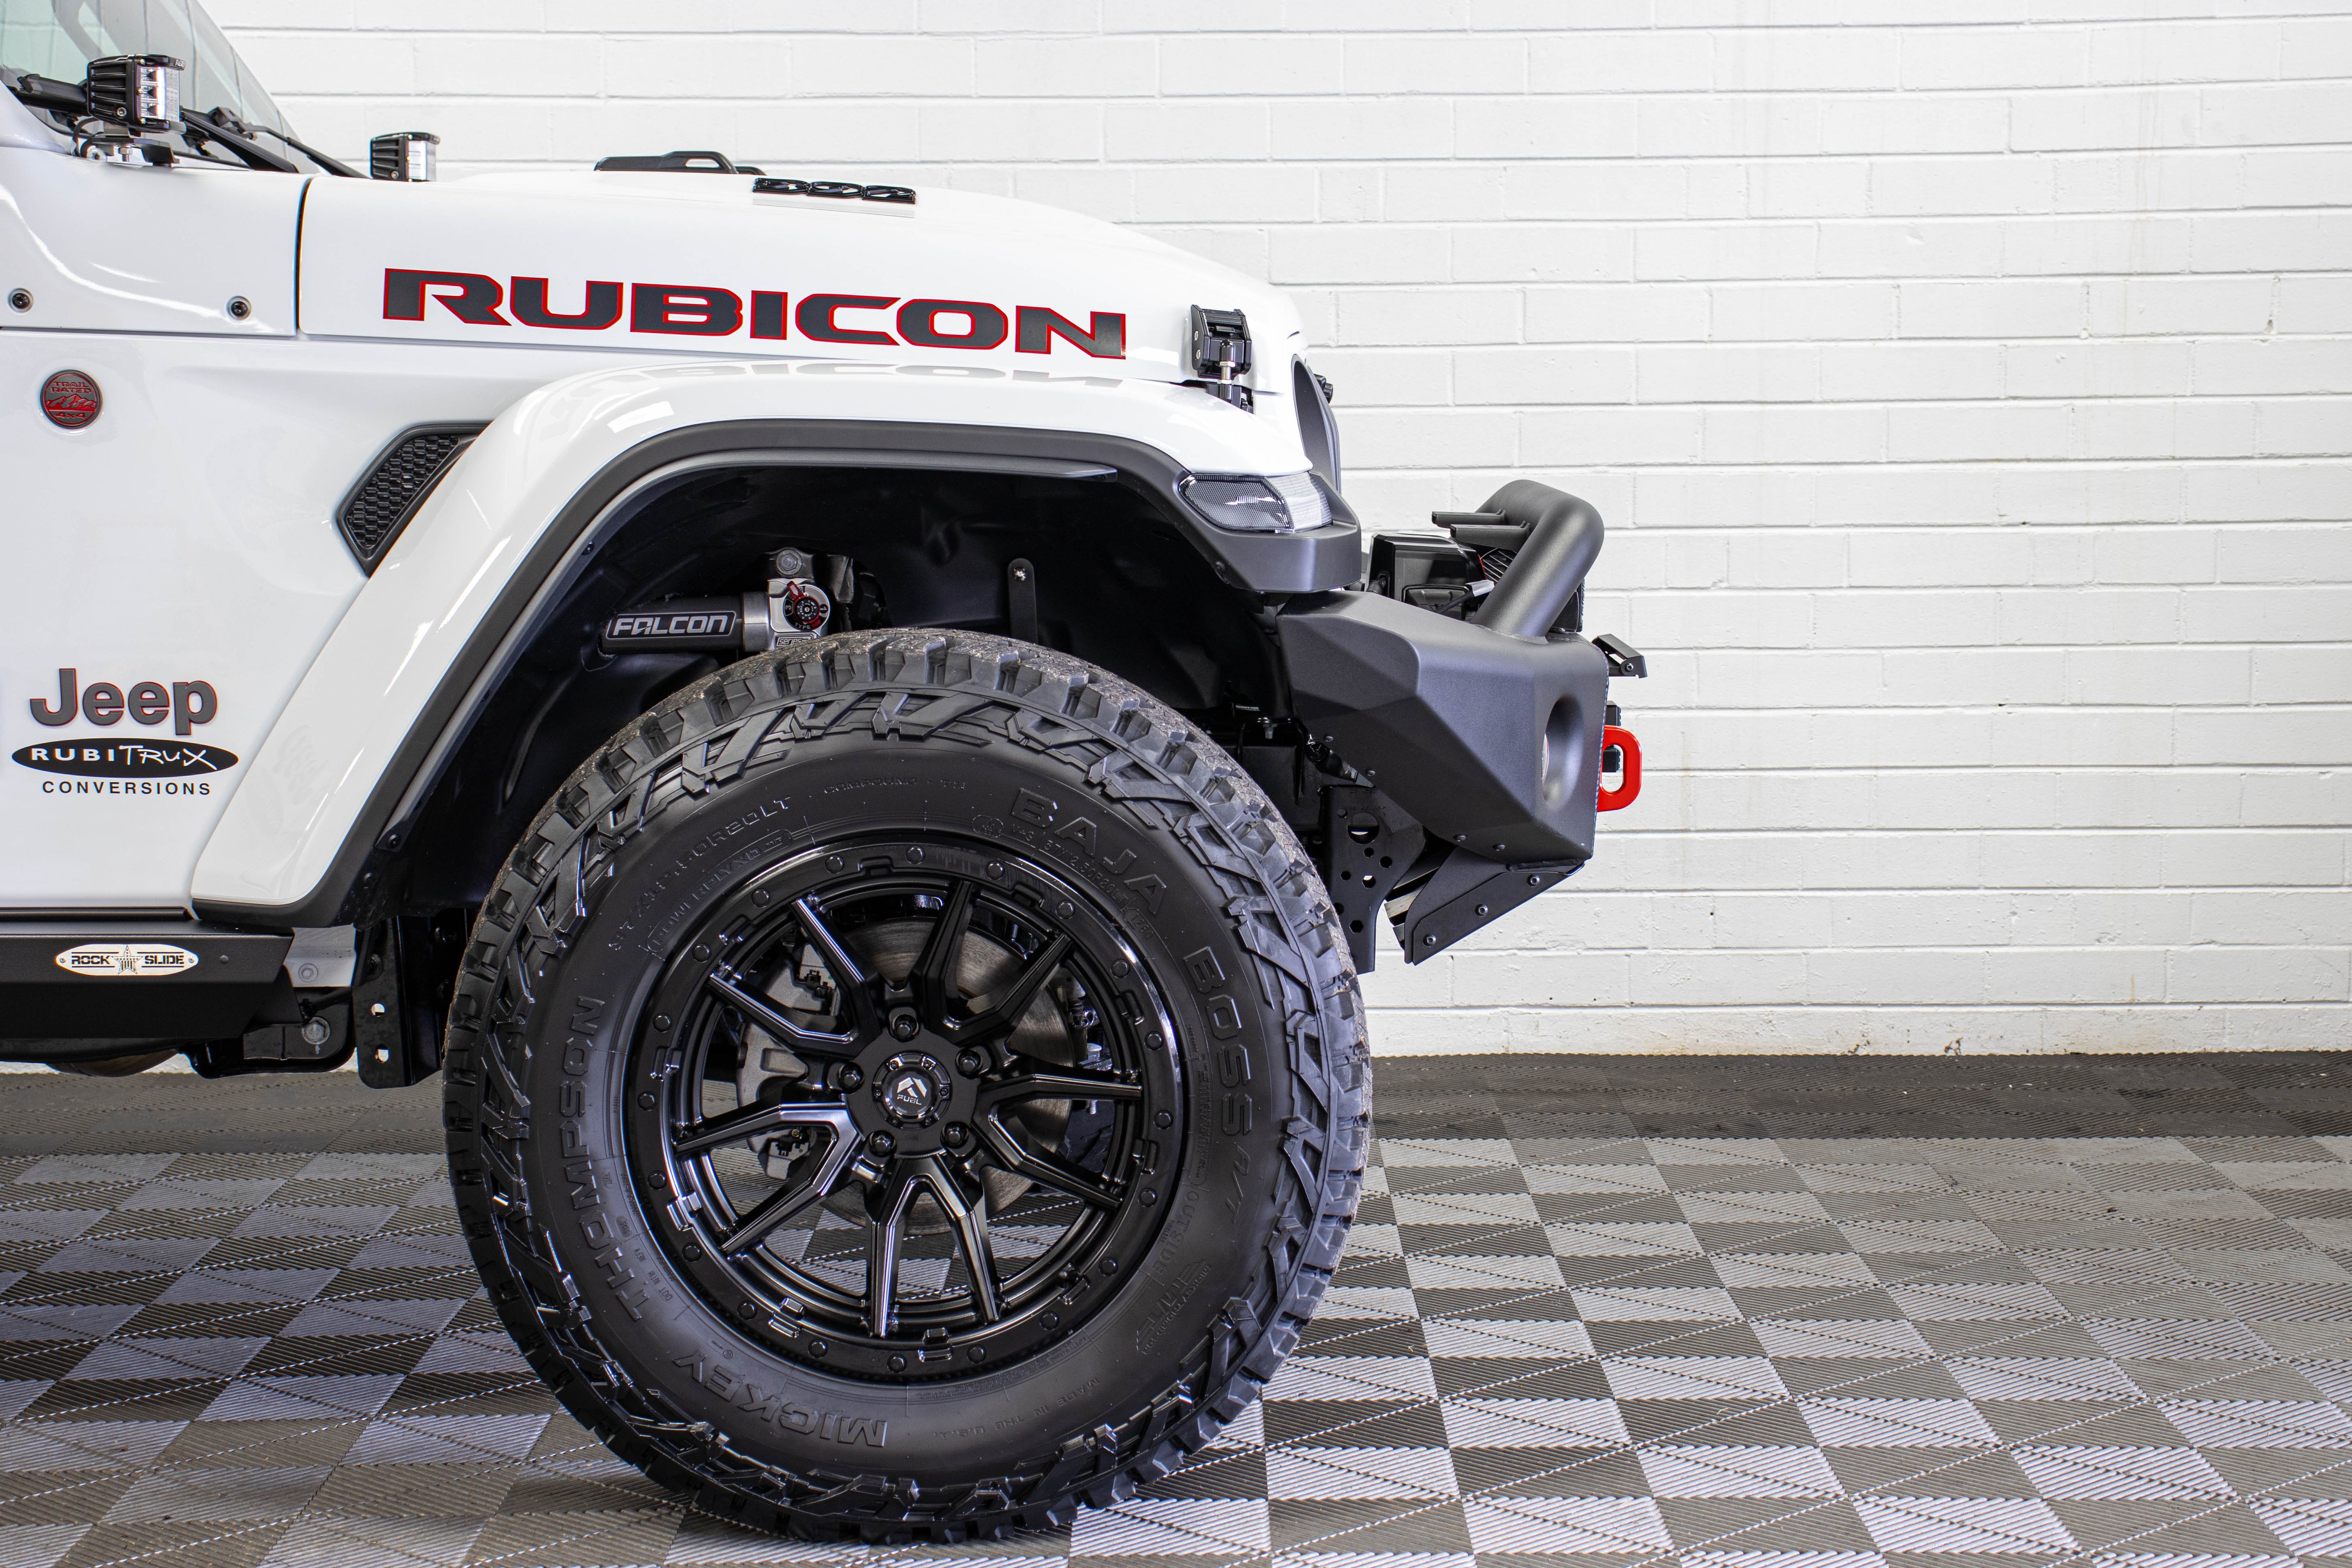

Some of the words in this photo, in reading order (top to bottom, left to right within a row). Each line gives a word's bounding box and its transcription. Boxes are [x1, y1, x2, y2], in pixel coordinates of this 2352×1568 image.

[382, 267, 1126, 360] RUBICON
[612, 615, 728, 635] FALCON
[30, 668, 217, 735] Jeep
[42, 781, 212, 795] CONVERSIONS
[71, 955, 110, 966] ROCK
[144, 955, 185, 966] SLIDE
[1011, 788, 1168, 917] BAJA
[1183, 946, 1251, 1136] BOSS
[897, 1094, 922, 1105] FUEL
[560, 996, 650, 1322] THOMPSON
[1151, 1189, 1200, 1275] OUTSIDE
[658, 1287, 673, 1301] DOT
[672, 1350, 888, 1447] MICKEY
[1055, 1376, 1101, 1407] MADE
[993, 1414, 1025, 1430] THE
[1032, 1404, 1050, 1417] IN
